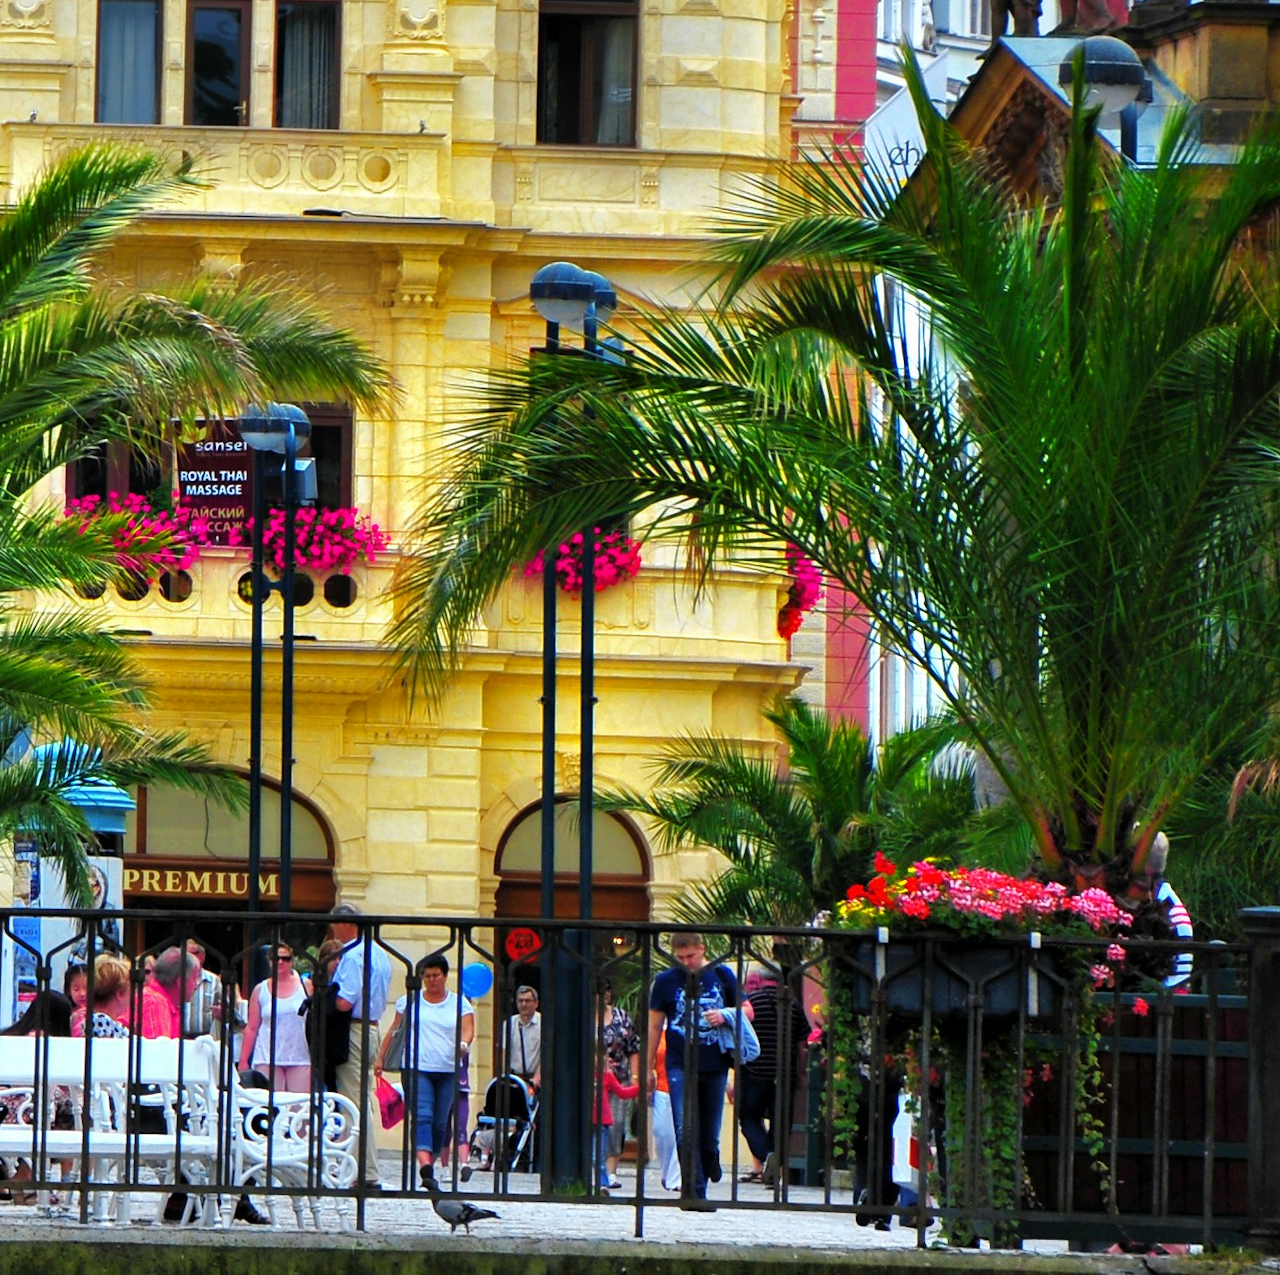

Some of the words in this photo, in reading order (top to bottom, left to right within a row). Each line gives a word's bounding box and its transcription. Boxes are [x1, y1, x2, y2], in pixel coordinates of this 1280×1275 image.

[180, 470, 218, 482] ROYAL
[219, 470, 248, 482] THAI
[186, 484, 242, 496] MASSAGE
[189, 505, 245, 519] АЙСКИЙ
[205, 521, 243, 533] ССАЖ
[123, 869, 279, 896] PREMIUM
